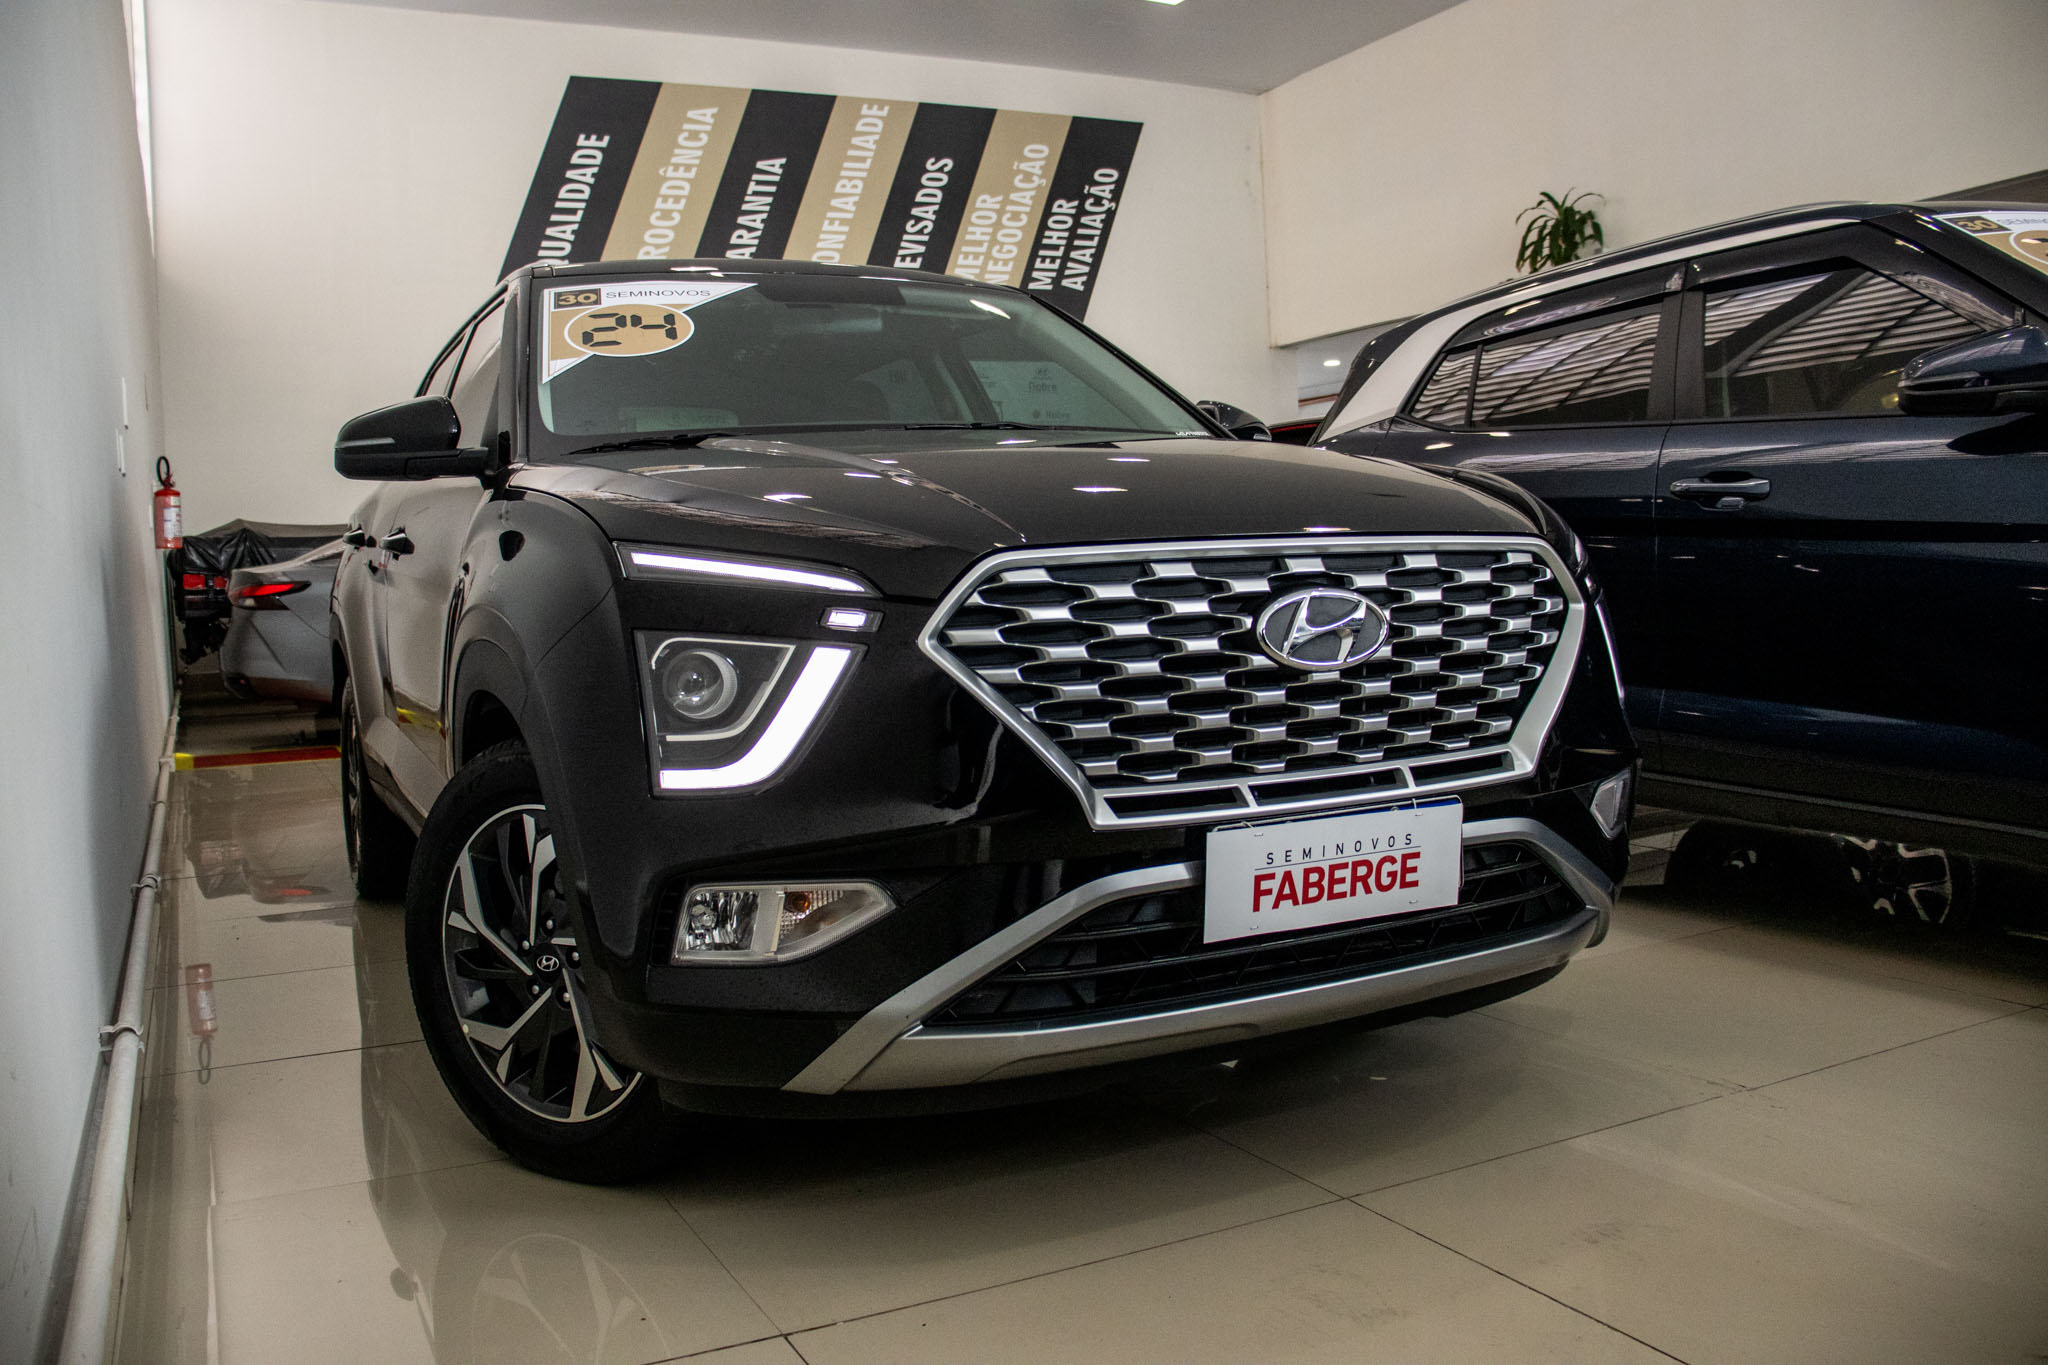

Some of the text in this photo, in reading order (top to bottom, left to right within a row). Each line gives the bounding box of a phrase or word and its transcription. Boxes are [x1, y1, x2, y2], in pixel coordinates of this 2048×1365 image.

[636, 105, 719, 260] ROCEDÊNCIA
[724, 156, 787, 259] ARANTIA
[811, 103, 890, 263] ONFIABILIADE
[893, 156, 954, 270] EVISADOS
[1060, 167, 1119, 292] AVALIAÇÃO
[1027, 199, 1079, 291] MELHOR
[558, 289, 711, 305] 30 SEMINOVOS
[581, 312, 678, 348] 24
[1252, 851, 1422, 913] FABERGE
[1265, 833, 1413, 865] SEMINOVOS
